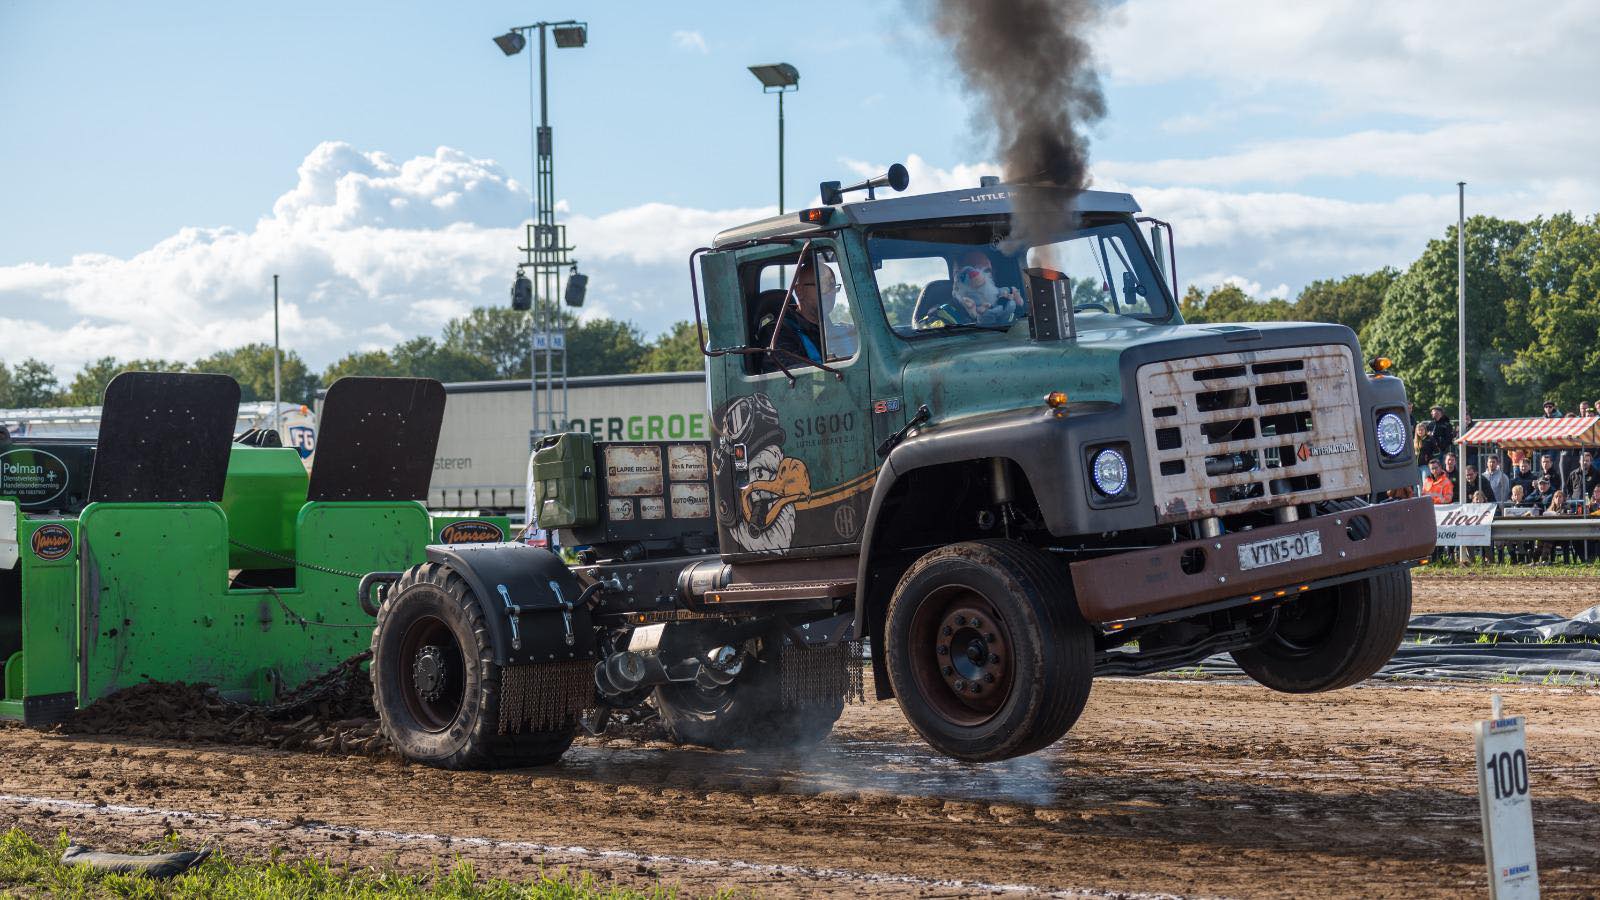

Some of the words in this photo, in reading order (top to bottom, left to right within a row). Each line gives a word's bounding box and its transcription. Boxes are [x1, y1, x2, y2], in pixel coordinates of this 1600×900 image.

[970, 191, 1006, 202] LITTLE
[1311, 442, 1358, 457] INTERNATIONAL
[3, 462, 43, 474] Polman
[444, 526, 499, 544] Jansen
[1486, 748, 1528, 800] 100
